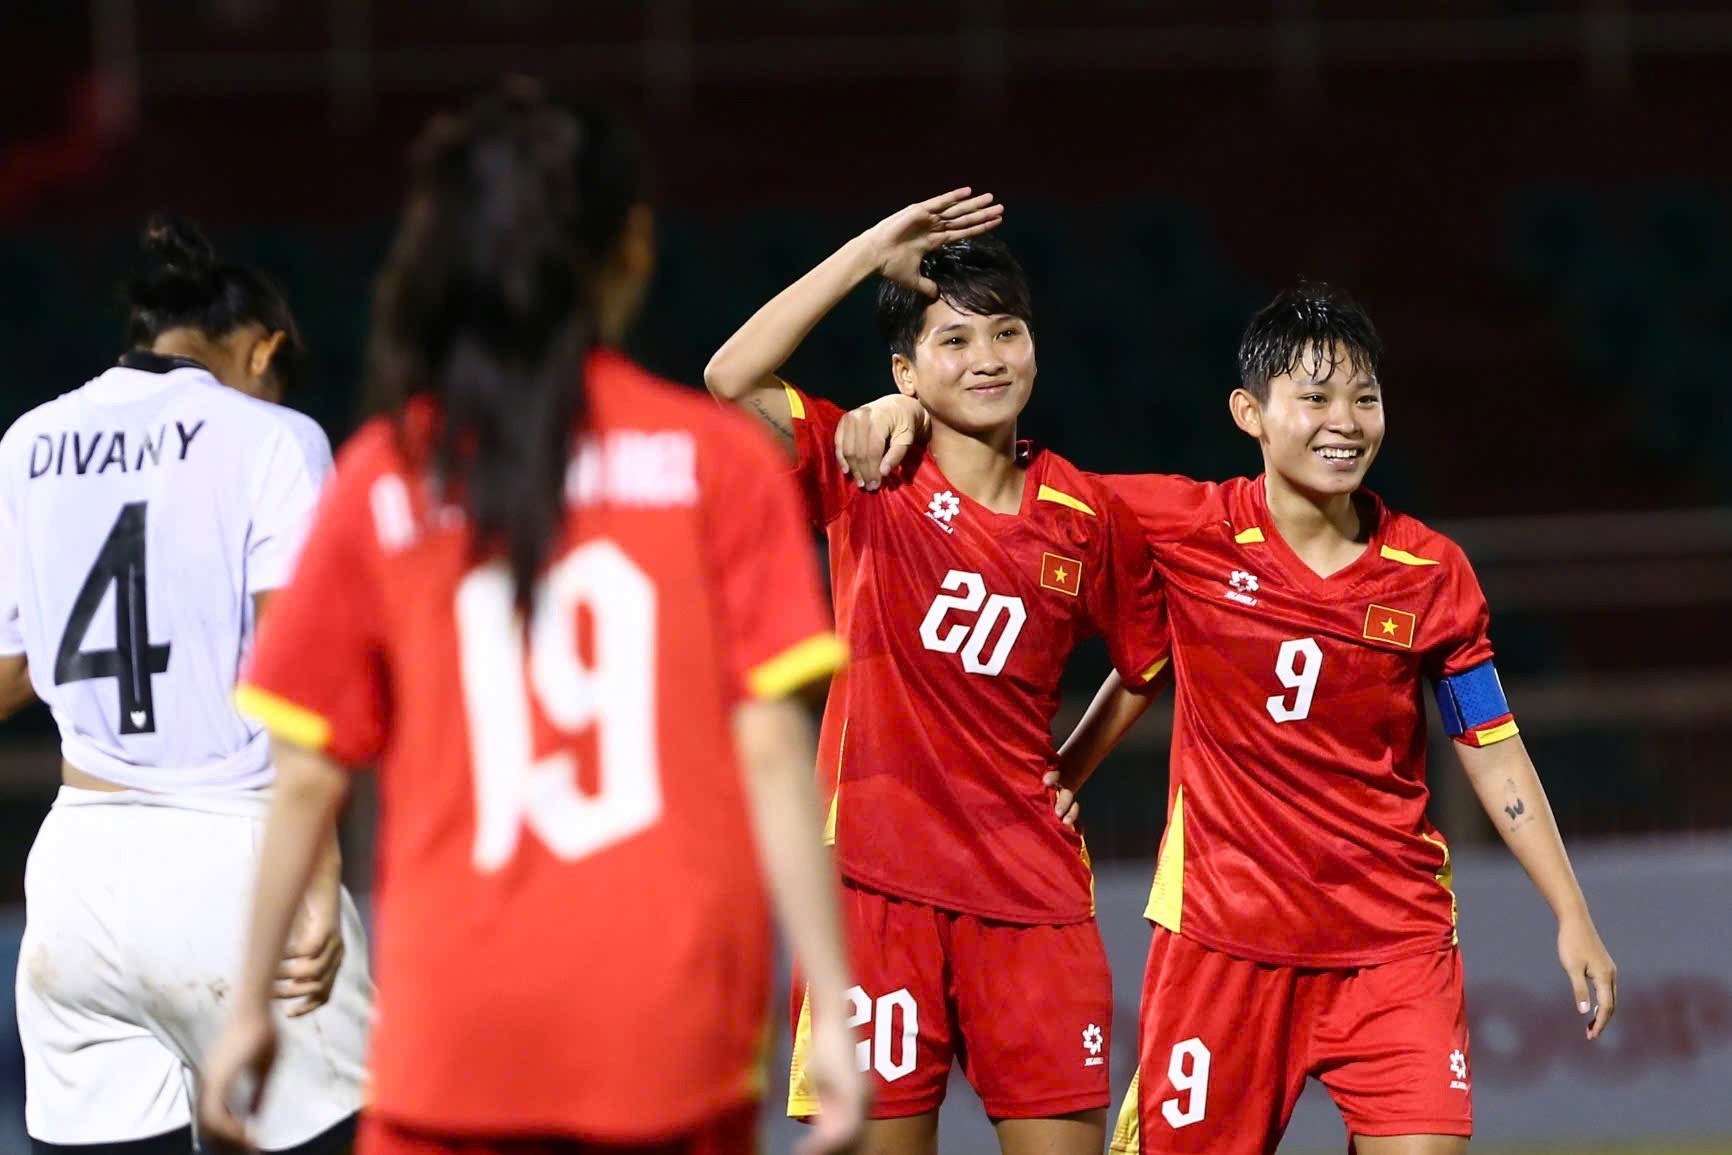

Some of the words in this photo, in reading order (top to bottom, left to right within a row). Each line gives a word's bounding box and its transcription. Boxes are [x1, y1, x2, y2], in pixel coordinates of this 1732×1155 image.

[30, 420, 206, 479] DIVANY
[54, 501, 172, 735] 4
[918, 569, 1028, 677] 20
[454, 538, 663, 875] 19
[1265, 636, 1324, 724] 9
[843, 984, 919, 1083] 20
[1161, 1036, 1211, 1129] 9
